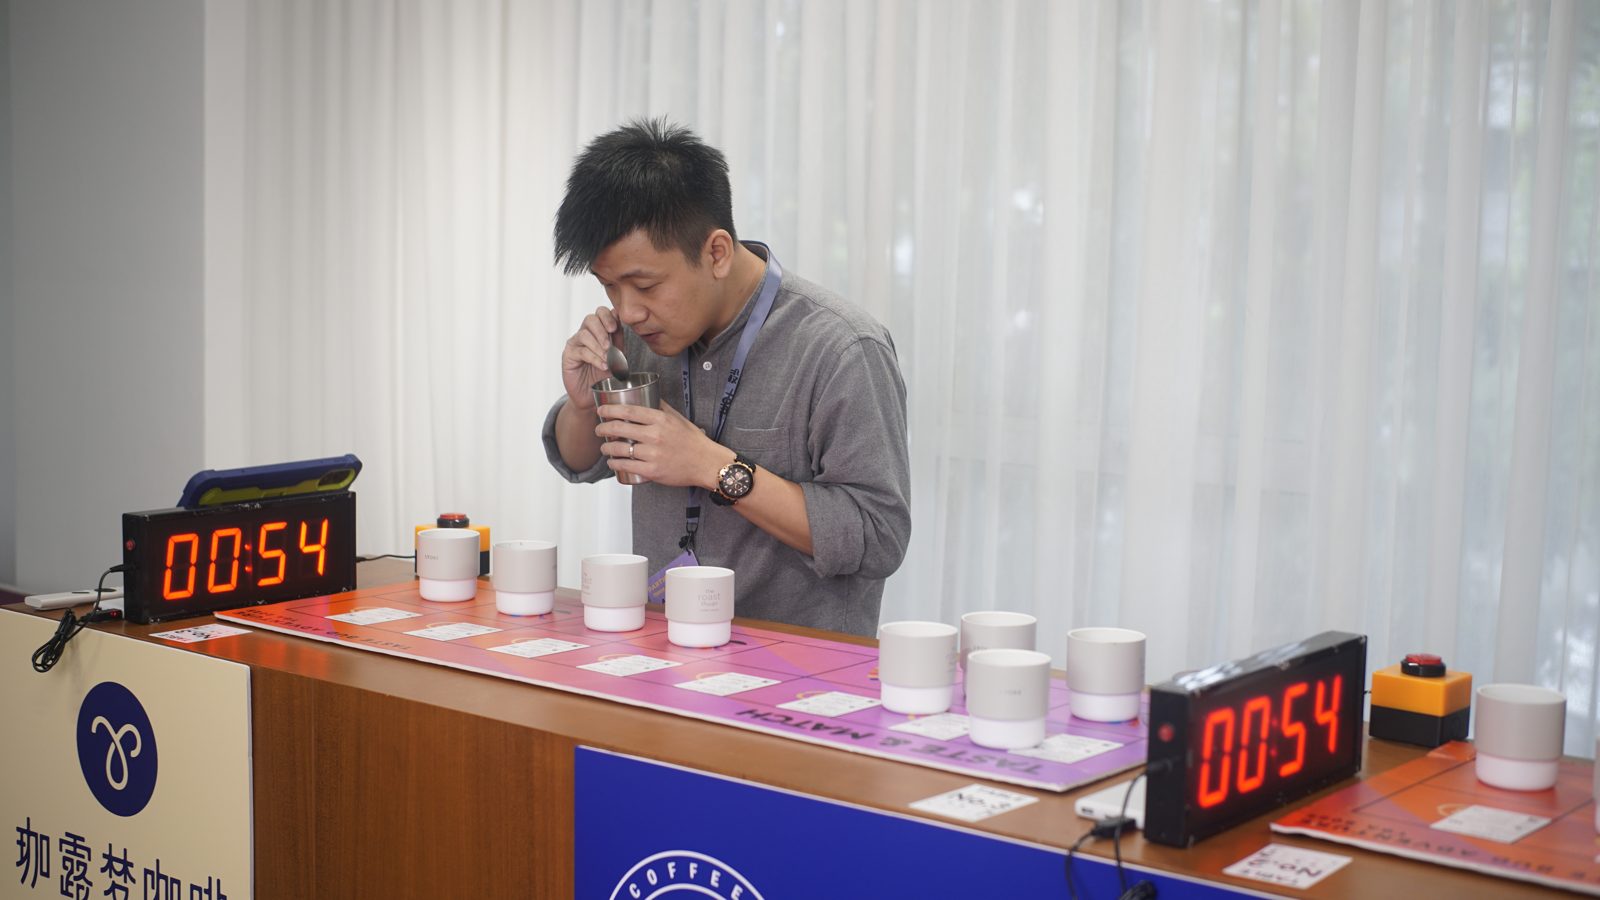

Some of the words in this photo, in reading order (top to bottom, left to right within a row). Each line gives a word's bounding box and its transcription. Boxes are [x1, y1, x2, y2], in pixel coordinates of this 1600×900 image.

[163, 518, 328, 600] 00:54
[697, 592, 720, 601] roast
[735, 707, 876, 741] MATCH
[1198, 674, 1342, 808] 00:54
[911, 741, 1044, 776] TASTE
[628, 861, 744, 900] COFFEE
